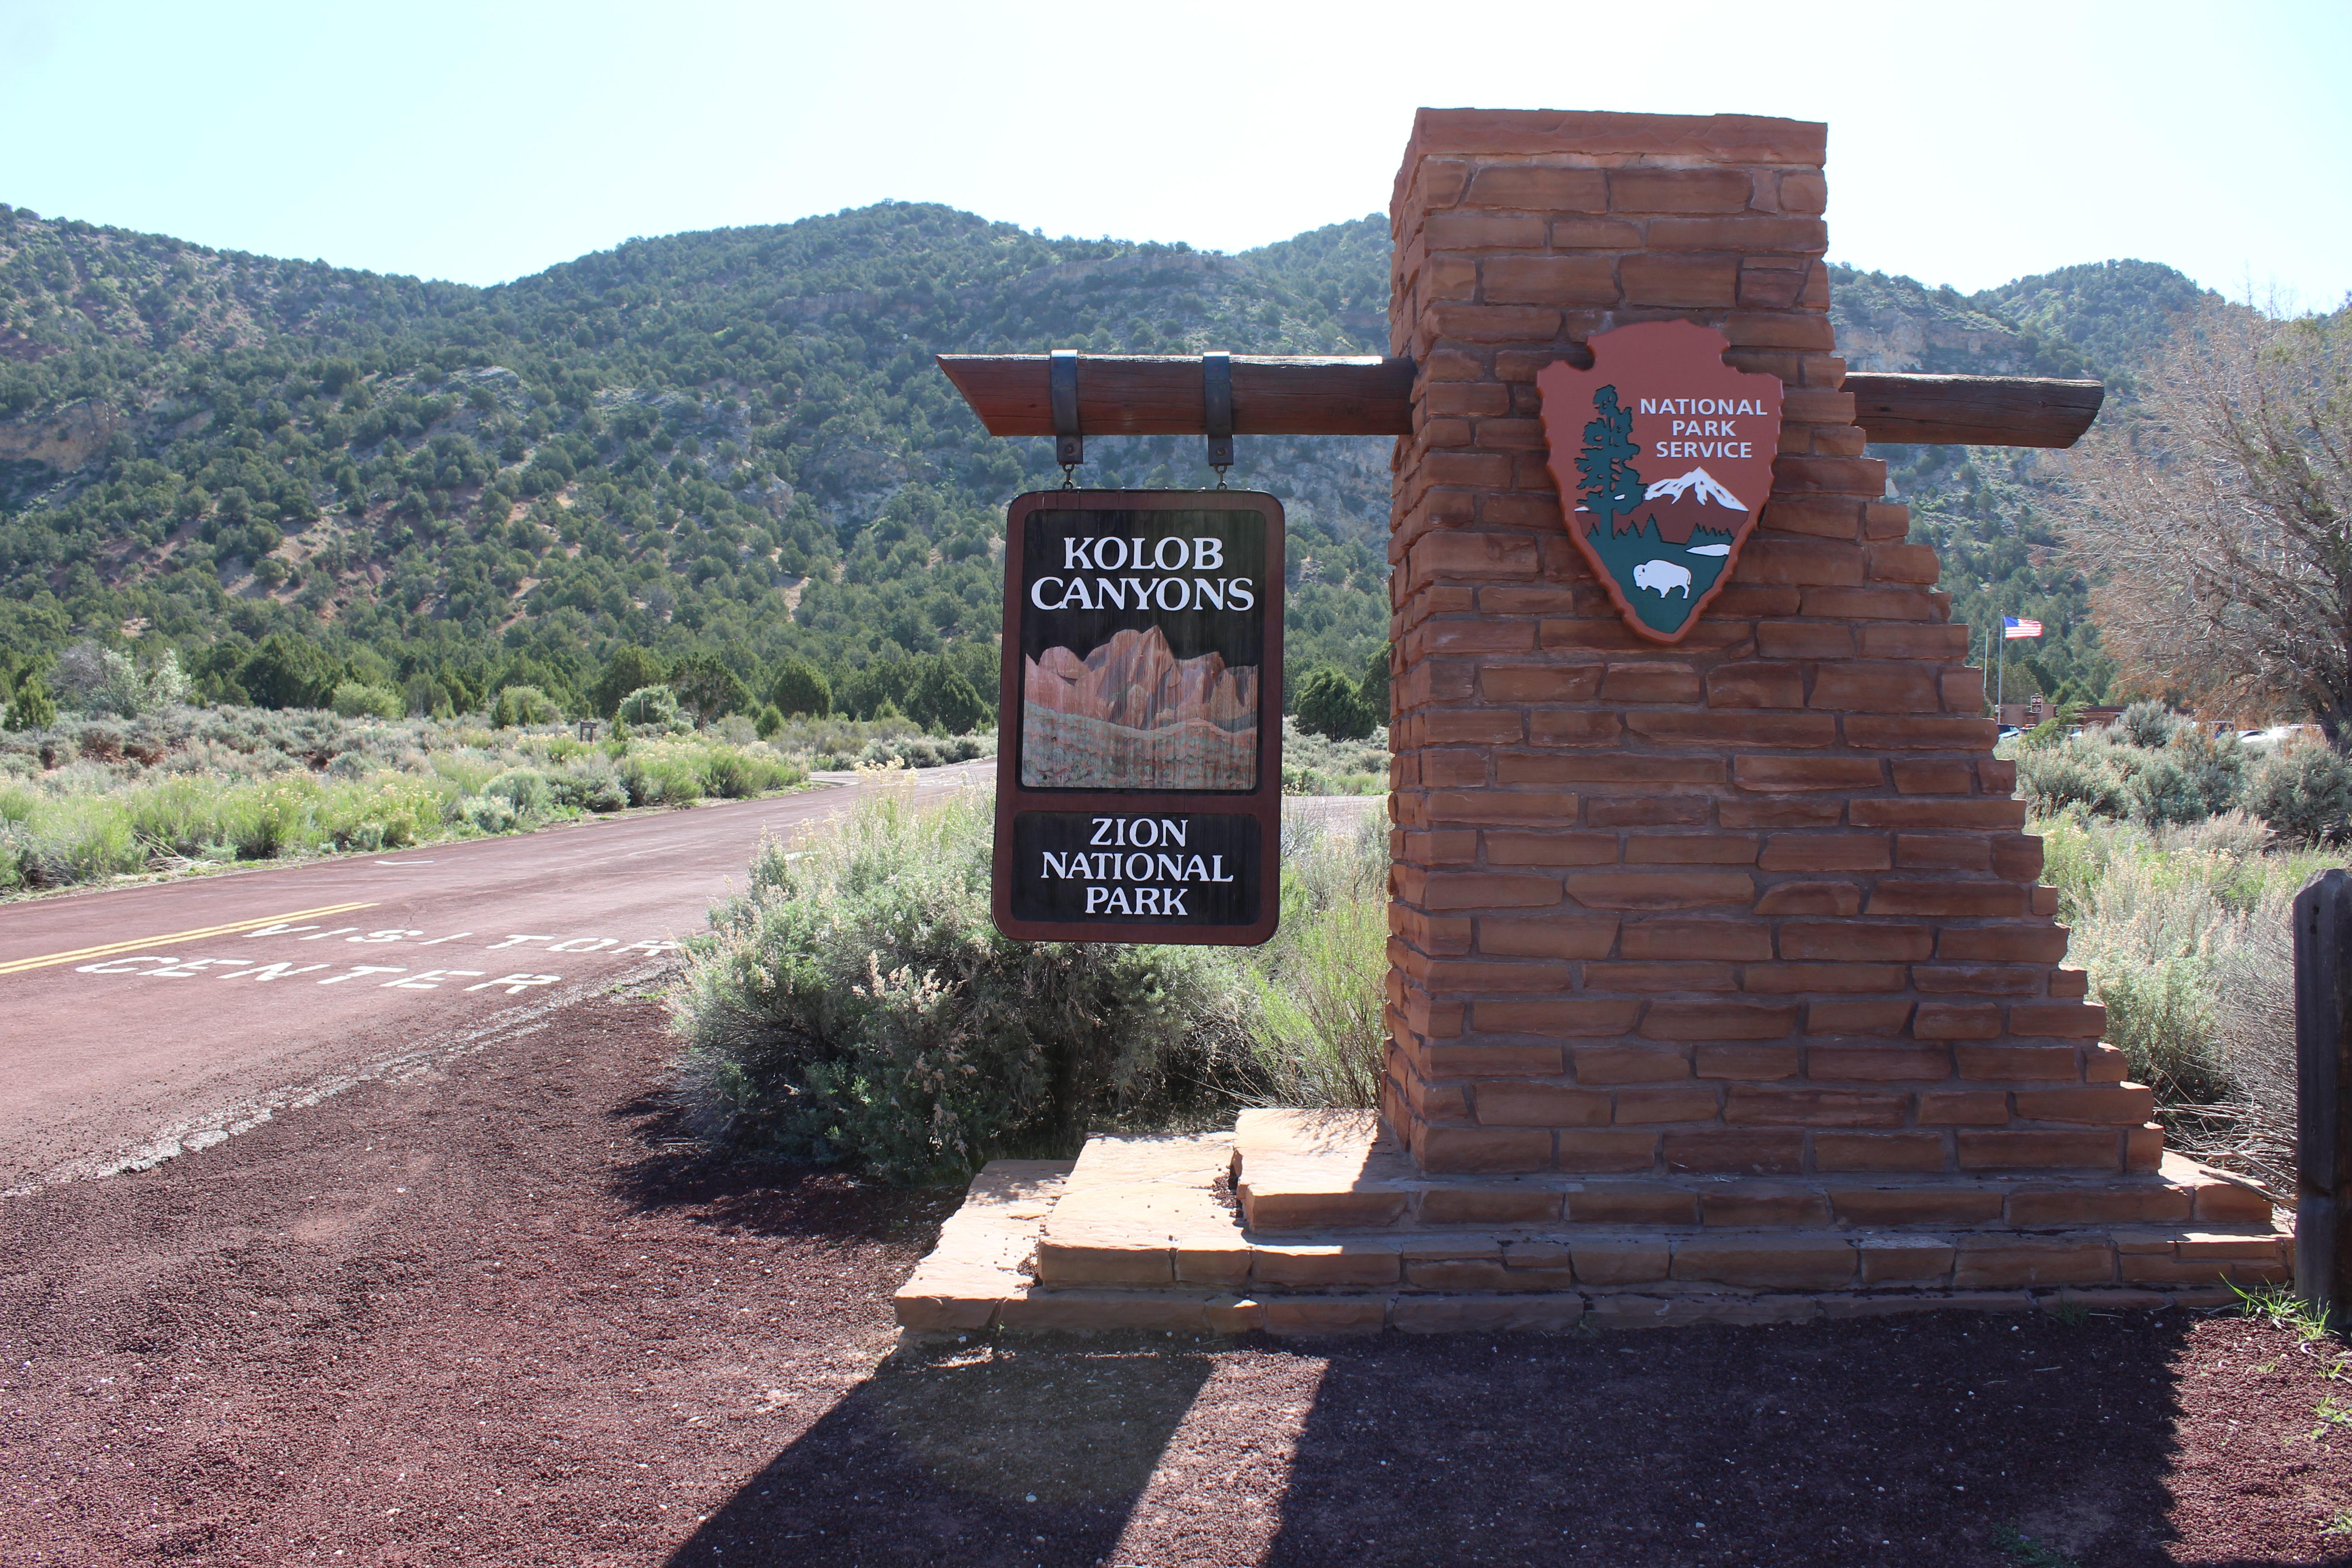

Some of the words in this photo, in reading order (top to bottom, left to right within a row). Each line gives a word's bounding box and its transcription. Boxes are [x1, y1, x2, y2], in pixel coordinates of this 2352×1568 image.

[1640, 398, 1768, 416] NATIONAL
[1672, 420, 1737, 437] PARK
[1656, 441, 1753, 458] SERVICE
[1063, 536, 1224, 570] KOLOB
[1030, 576, 1254, 611] CANYONS
[1089, 818, 1188, 848] ZION
[1040, 851, 1234, 882] NATIONAL
[1085, 887, 1188, 916] PARK
[242, 924, 681, 956] VISITOR
[75, 956, 562, 994] CENTER
